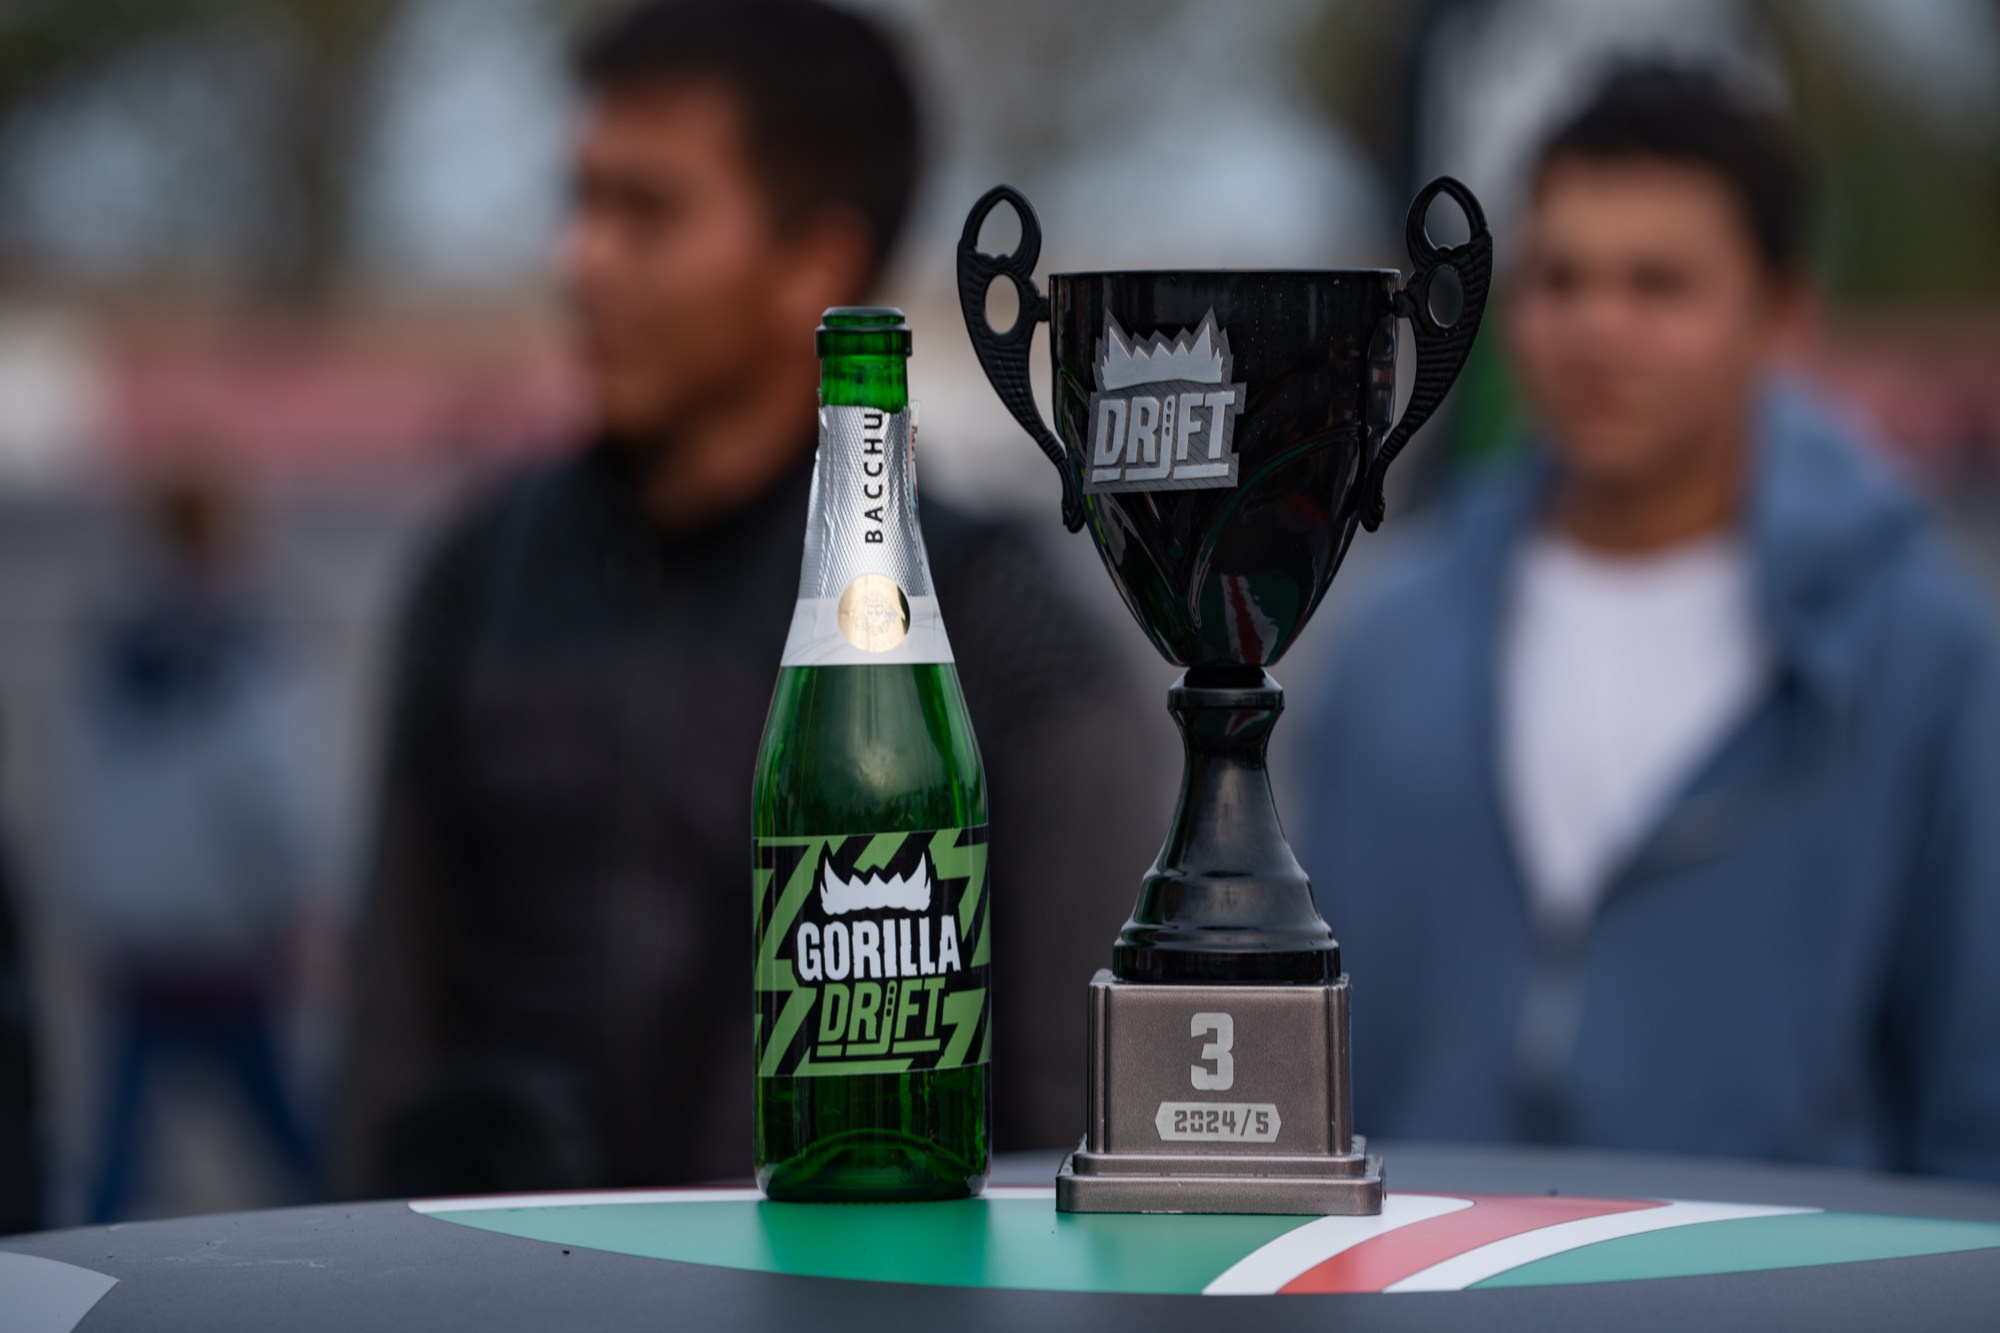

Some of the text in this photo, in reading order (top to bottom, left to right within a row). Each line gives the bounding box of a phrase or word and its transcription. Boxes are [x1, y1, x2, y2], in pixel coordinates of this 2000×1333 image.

[1092, 390, 1236, 481] DRIFT
[864, 413, 883, 544] BACCHU
[797, 915, 961, 981] GORILLA
[817, 977, 945, 1057] DRIFT
[1190, 1012, 1234, 1091] 3
[1174, 1109, 1269, 1136] 2024/5
